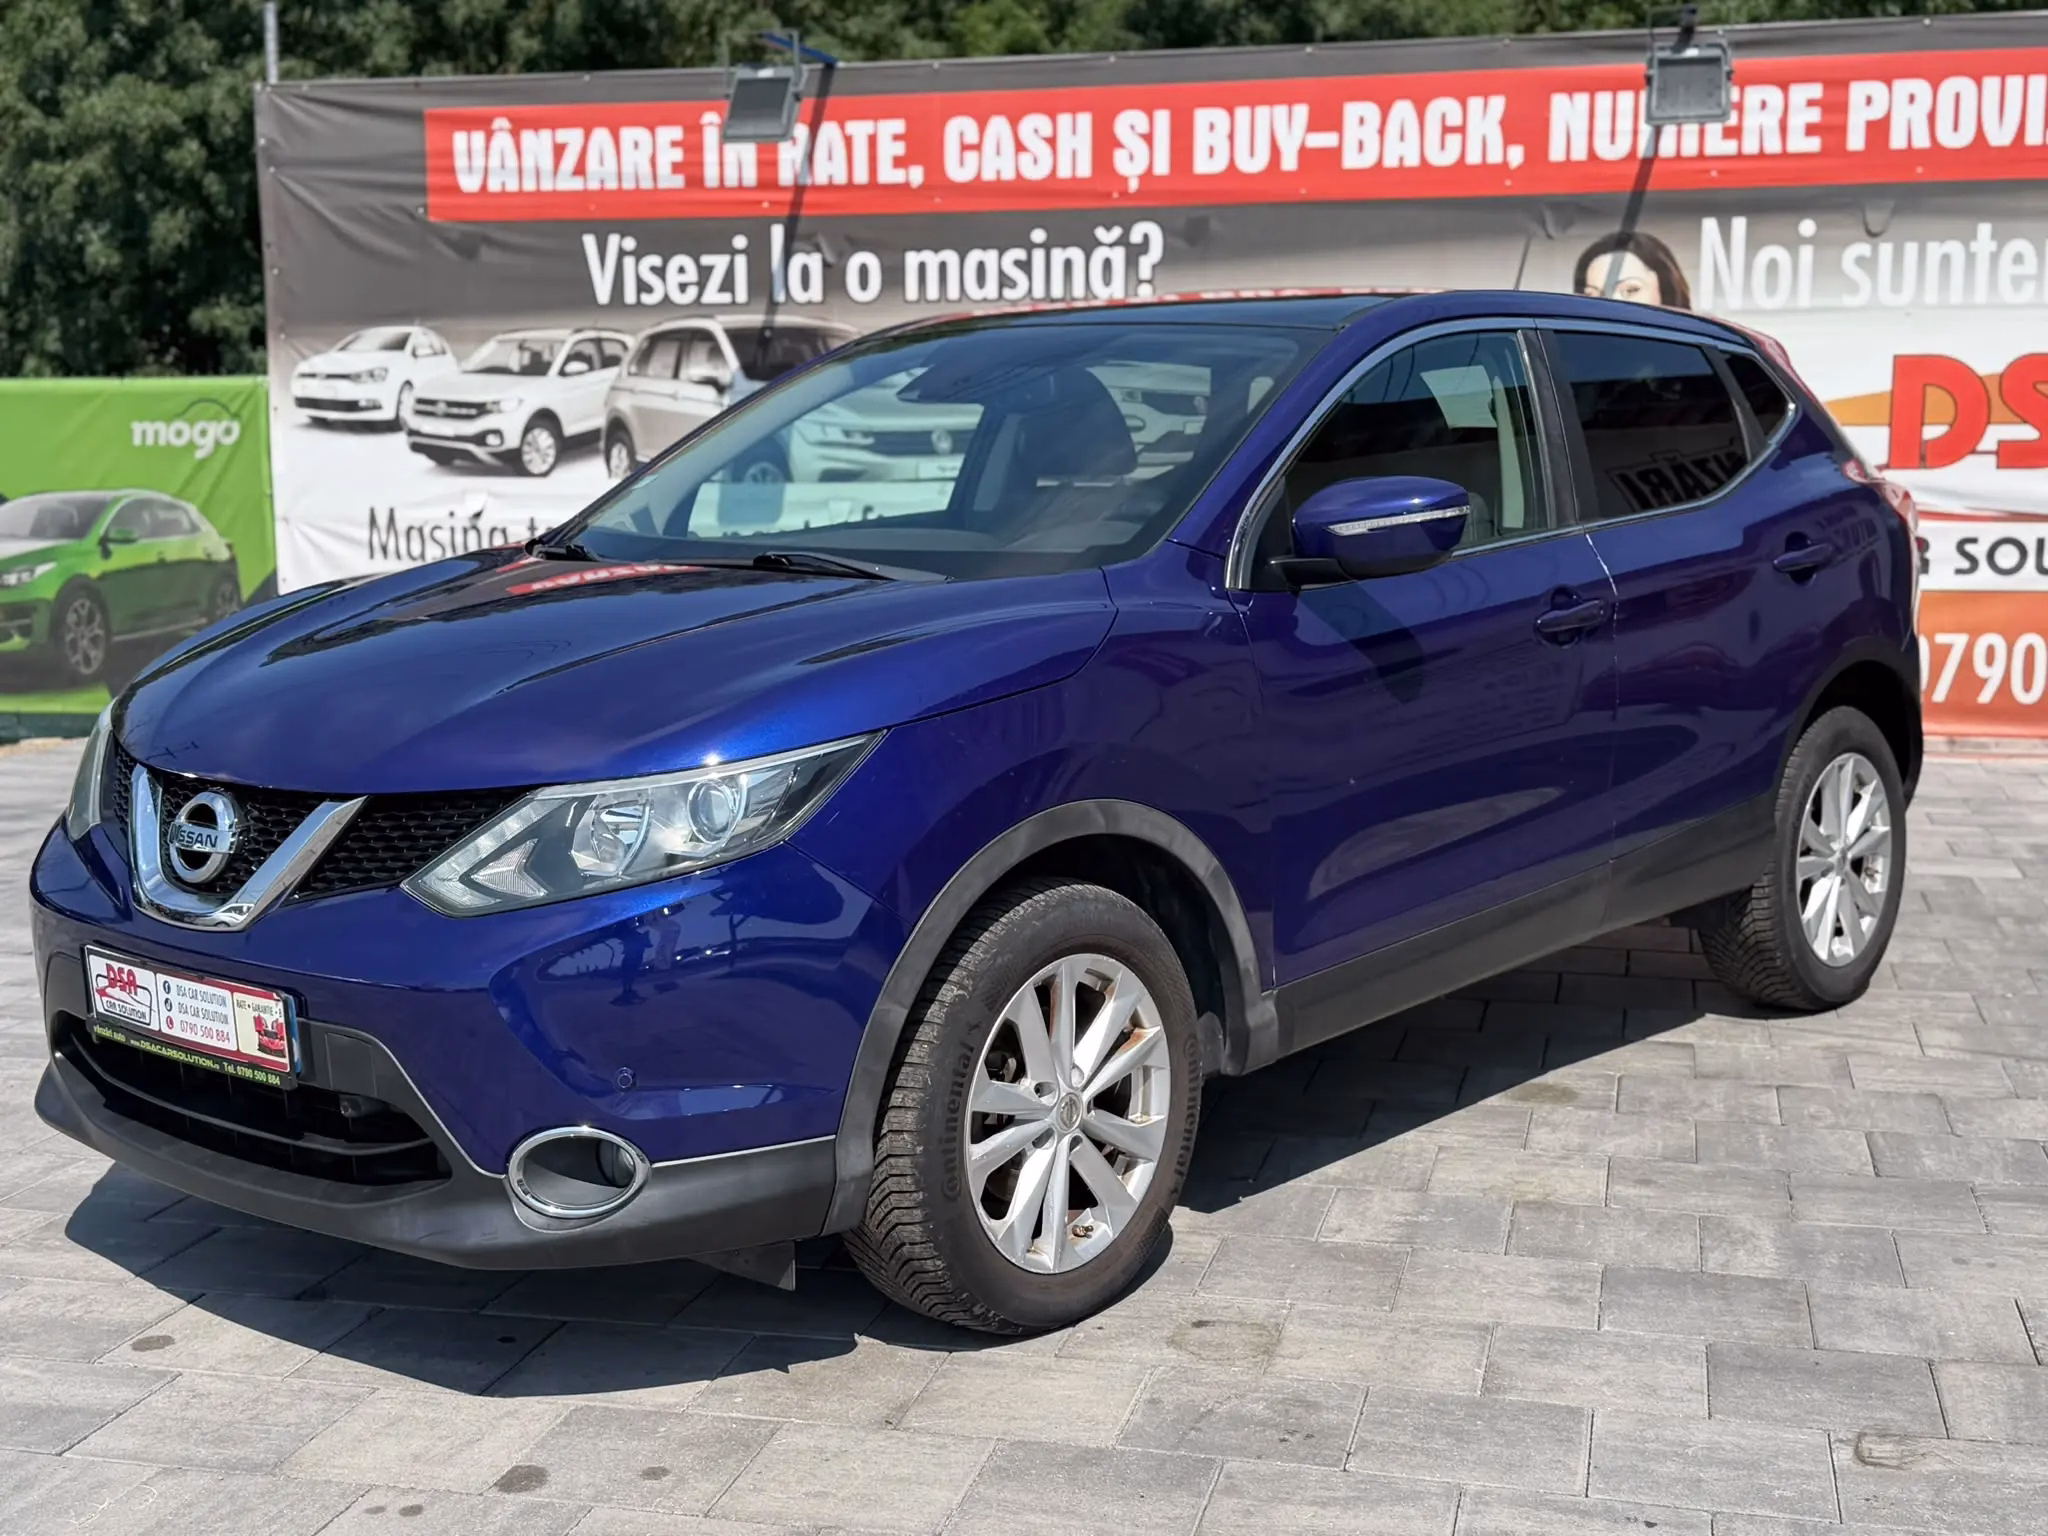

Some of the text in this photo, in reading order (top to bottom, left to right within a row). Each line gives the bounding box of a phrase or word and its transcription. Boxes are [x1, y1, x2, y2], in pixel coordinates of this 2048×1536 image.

[453, 117, 686, 194] VÂNZARE
[777, 119, 925, 188] RATE,
[943, 111, 1093, 183] CASH
[1112, 108, 1171, 193] ȘI
[1193, 95, 1525, 175] BUY-BACK,
[581, 233, 749, 305] Visezi
[770, 223, 825, 304] la
[845, 251, 883, 305] o
[904, 220, 1164, 301] masină?
[1700, 216, 2048, 310] Noi sunte
[131, 419, 240, 460] mogo
[1919, 632, 2047, 704] 790
[169, 821, 219, 849] NISSAN
[106, 963, 138, 997] DSA
[176, 984, 228, 1008] DSA CAR SOLUTION
[177, 1002, 229, 1025] DSA CAR SOLUTION
[180, 1019, 231, 1044] 0790 500 884
[236, 1065, 253, 1078] 0790
[254, 1070, 267, 1082] 500
[267, 1073, 280, 1086] 884
